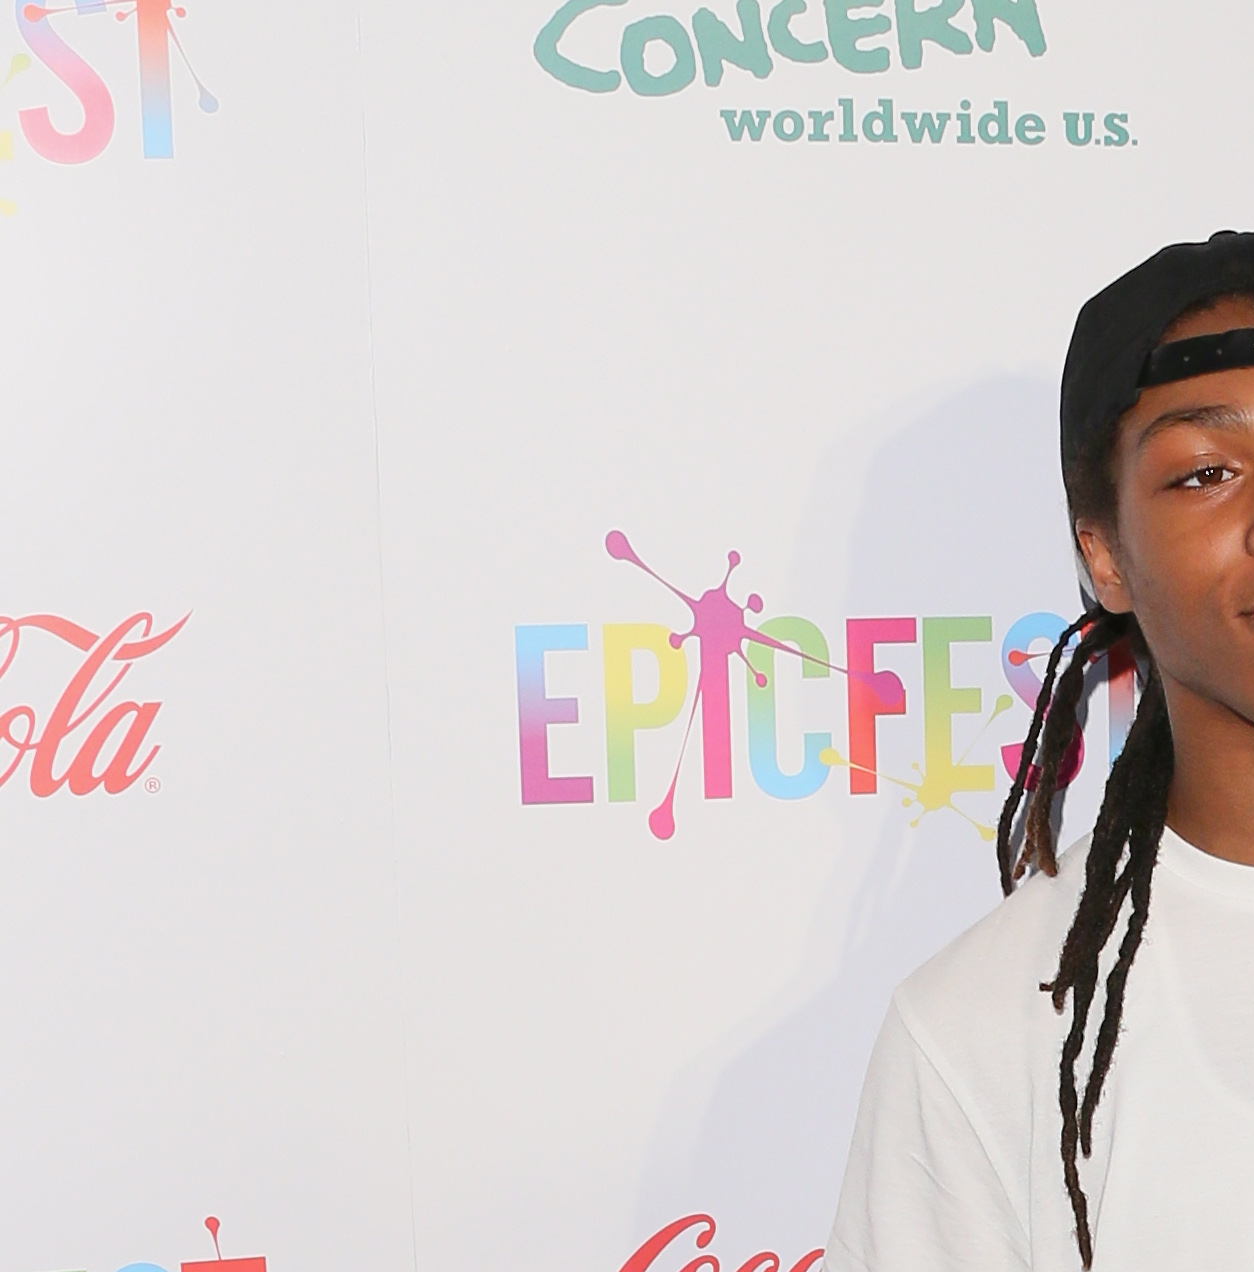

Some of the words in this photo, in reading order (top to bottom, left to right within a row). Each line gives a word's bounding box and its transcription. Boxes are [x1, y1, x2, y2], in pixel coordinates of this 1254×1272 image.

[0, 0, 174, 164] ST
[533, 0, 1047, 96] CONCERN
[720, 99, 1047, 145] worldwide
[1063, 111, 1138, 147] U.S.
